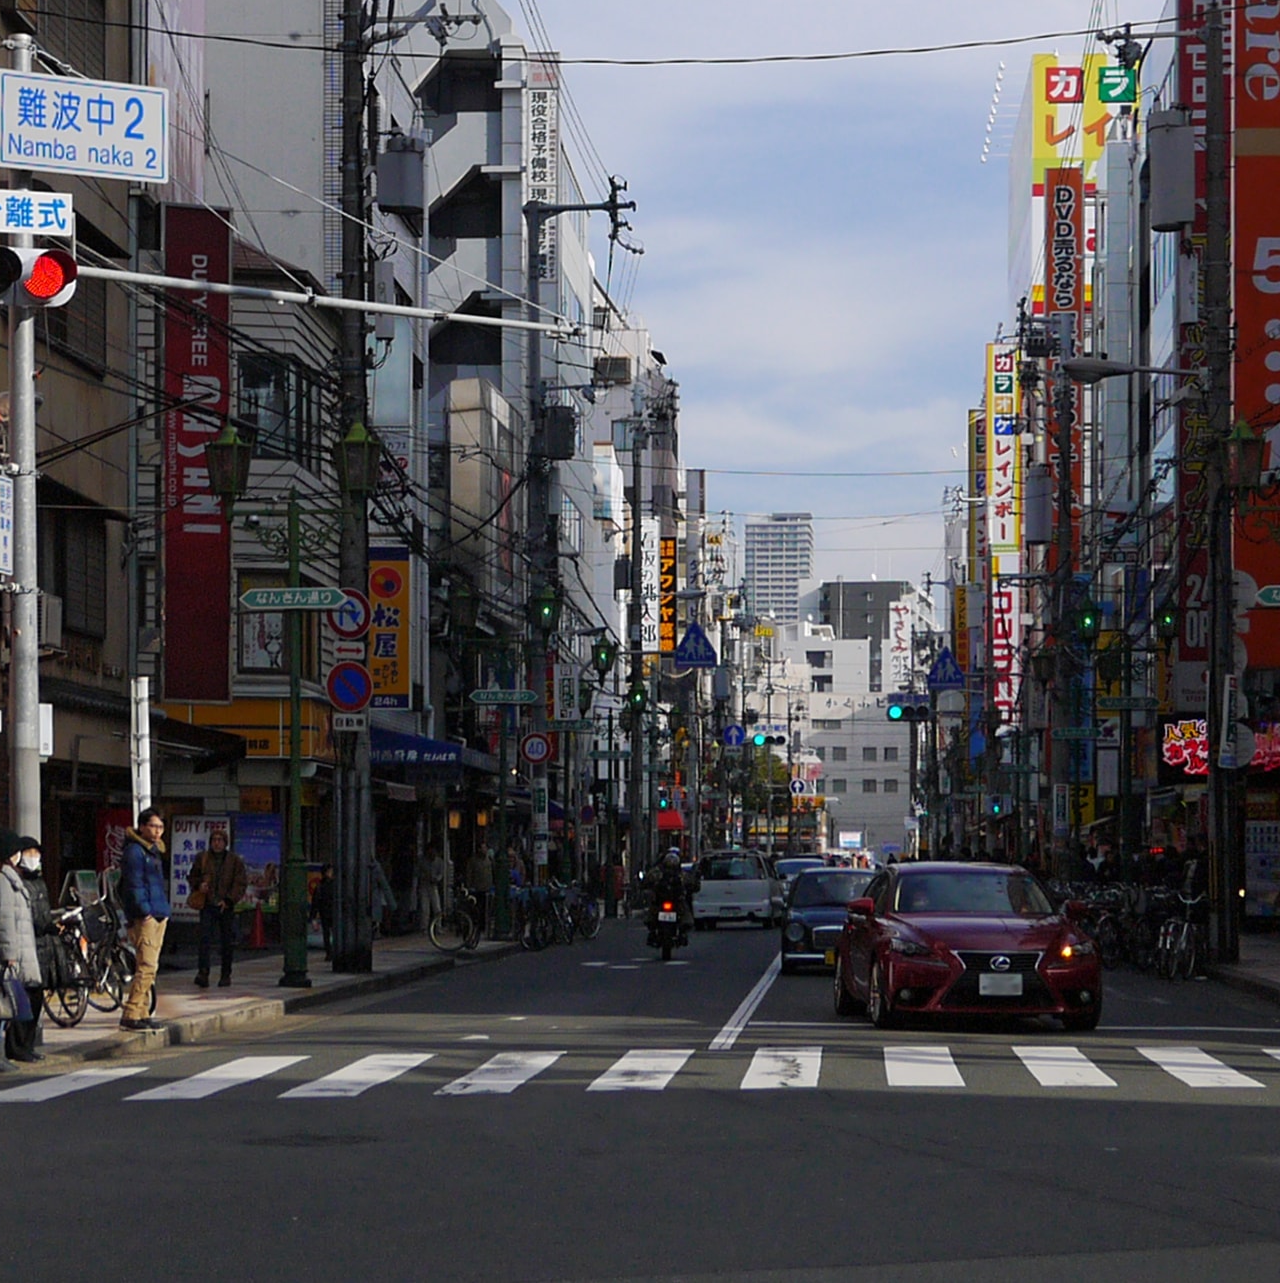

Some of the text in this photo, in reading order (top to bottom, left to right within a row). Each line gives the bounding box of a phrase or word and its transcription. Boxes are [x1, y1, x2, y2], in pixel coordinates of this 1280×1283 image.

[18, 84, 146, 142] 難波中2
[8, 134, 158, 169] Namba naka 2
[531, 91, 548, 184] 現役合格予備校
[1052, 187, 1075, 307] DVD売るなら
[371, 603, 401, 658] 松屋
[334, 717, 364, 729] 自動車
[526, 741, 546, 757] 40
[174, 820, 201, 833] DUTY
